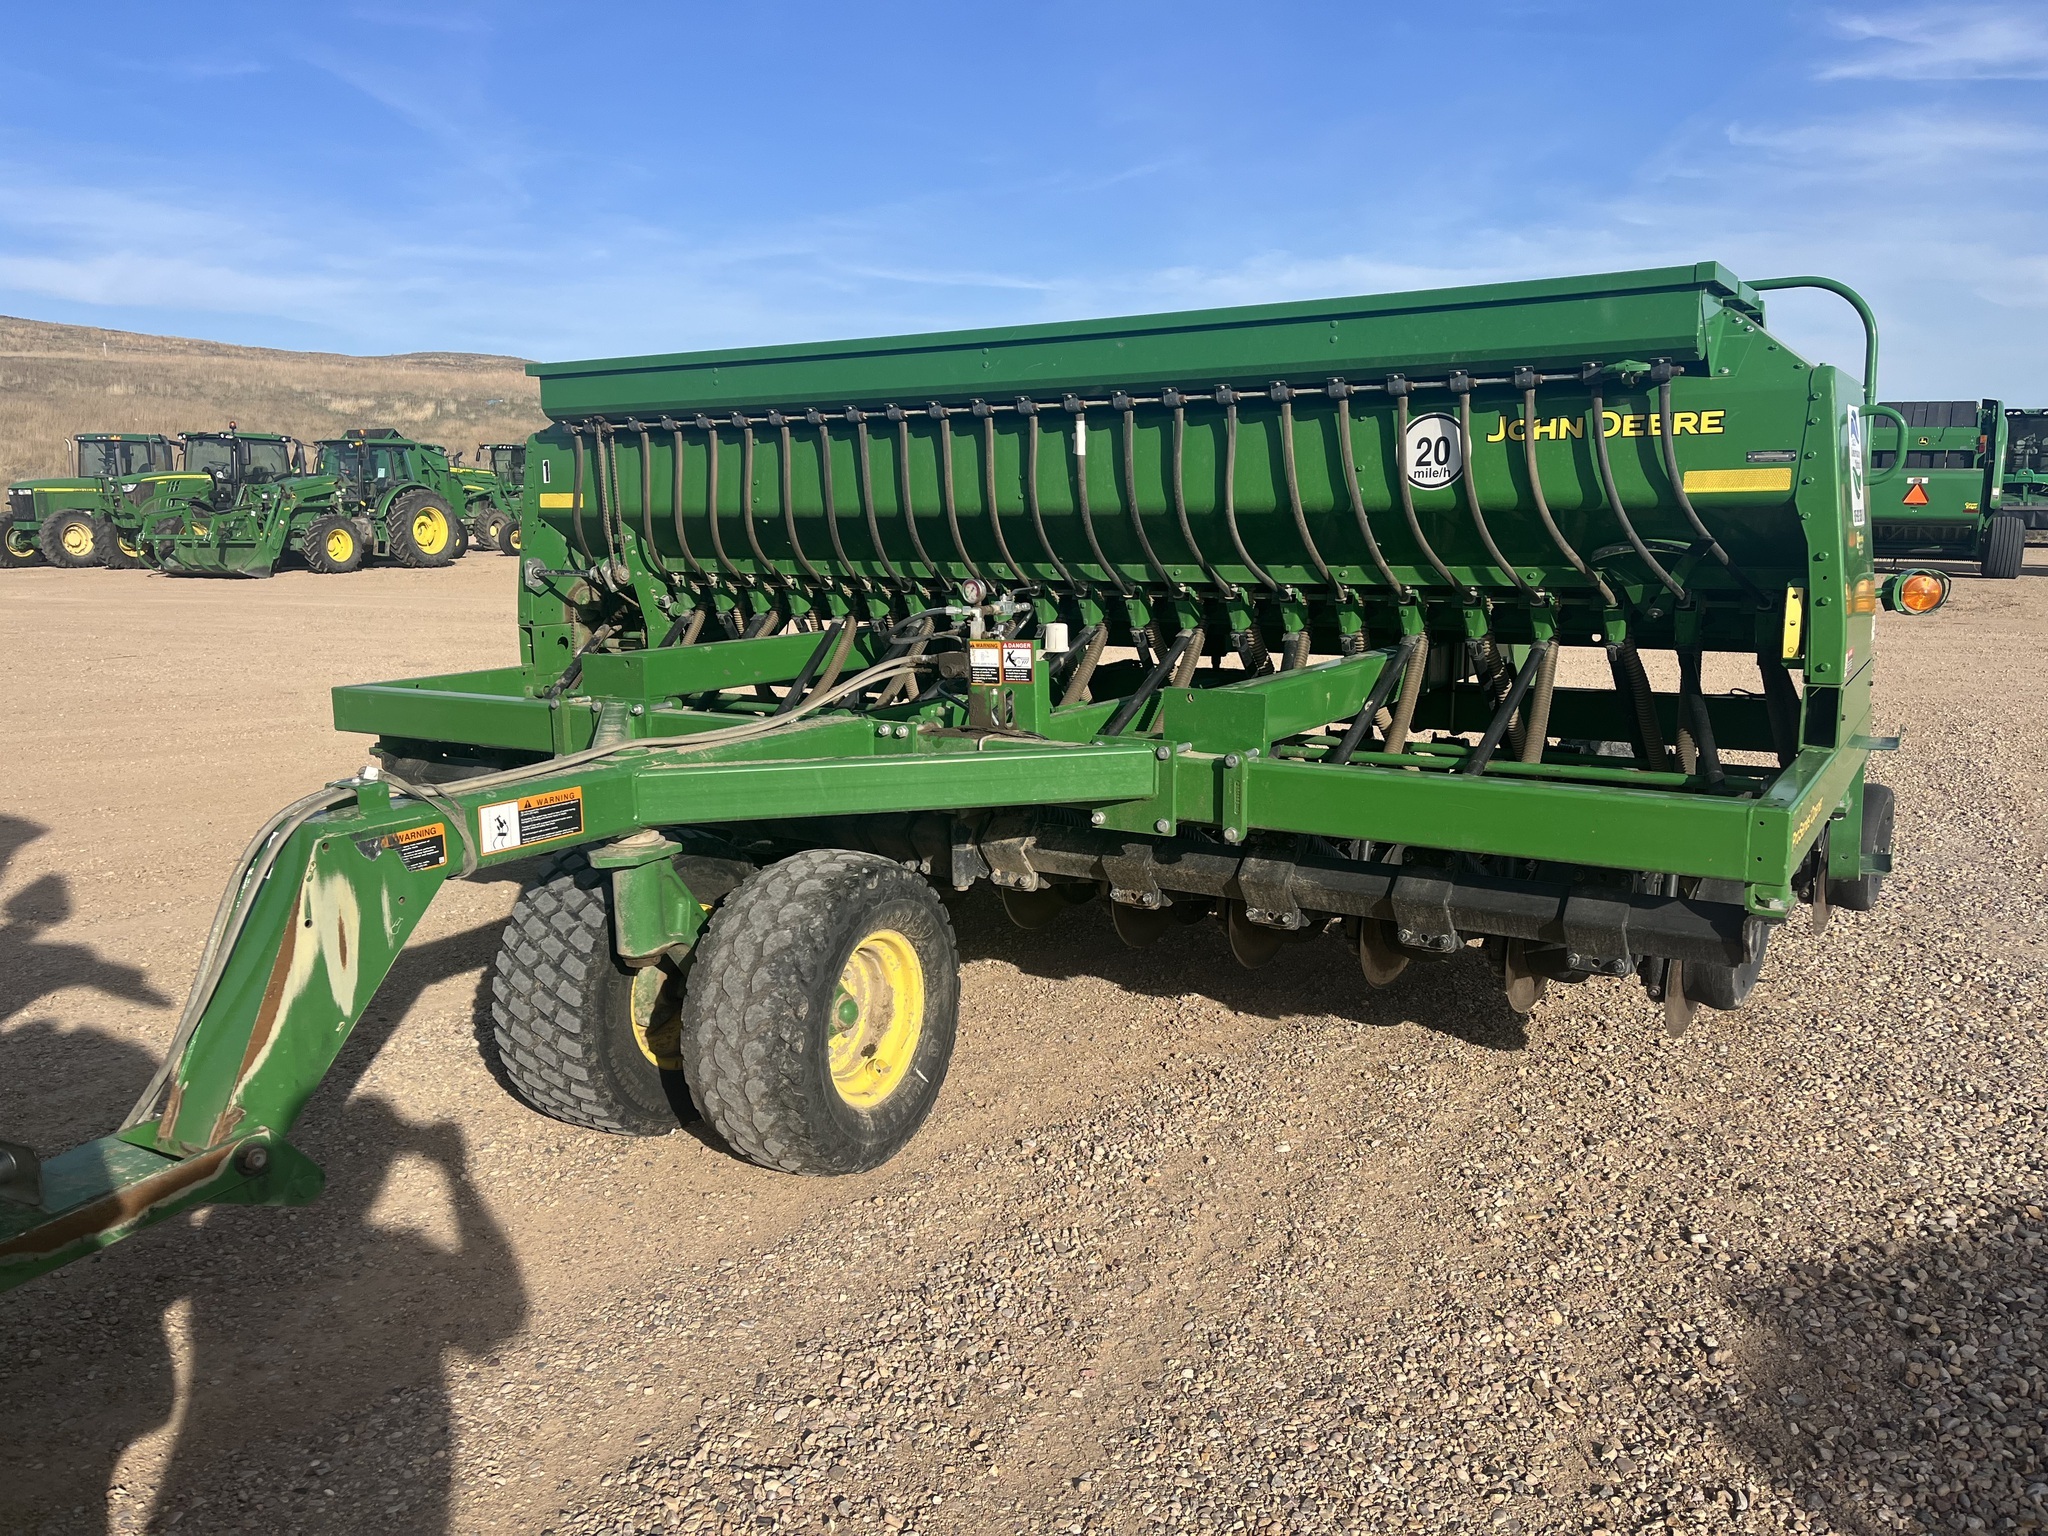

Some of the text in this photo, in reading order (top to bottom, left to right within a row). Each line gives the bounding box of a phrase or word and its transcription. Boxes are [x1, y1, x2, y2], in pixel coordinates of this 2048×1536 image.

[1486, 410, 1726, 443] JOHN DEERE
[1415, 436, 1451, 467] 20
[543, 460, 549, 482] 1
[1413, 467, 1451, 479] mile/h
[536, 791, 575, 807] WARNING
